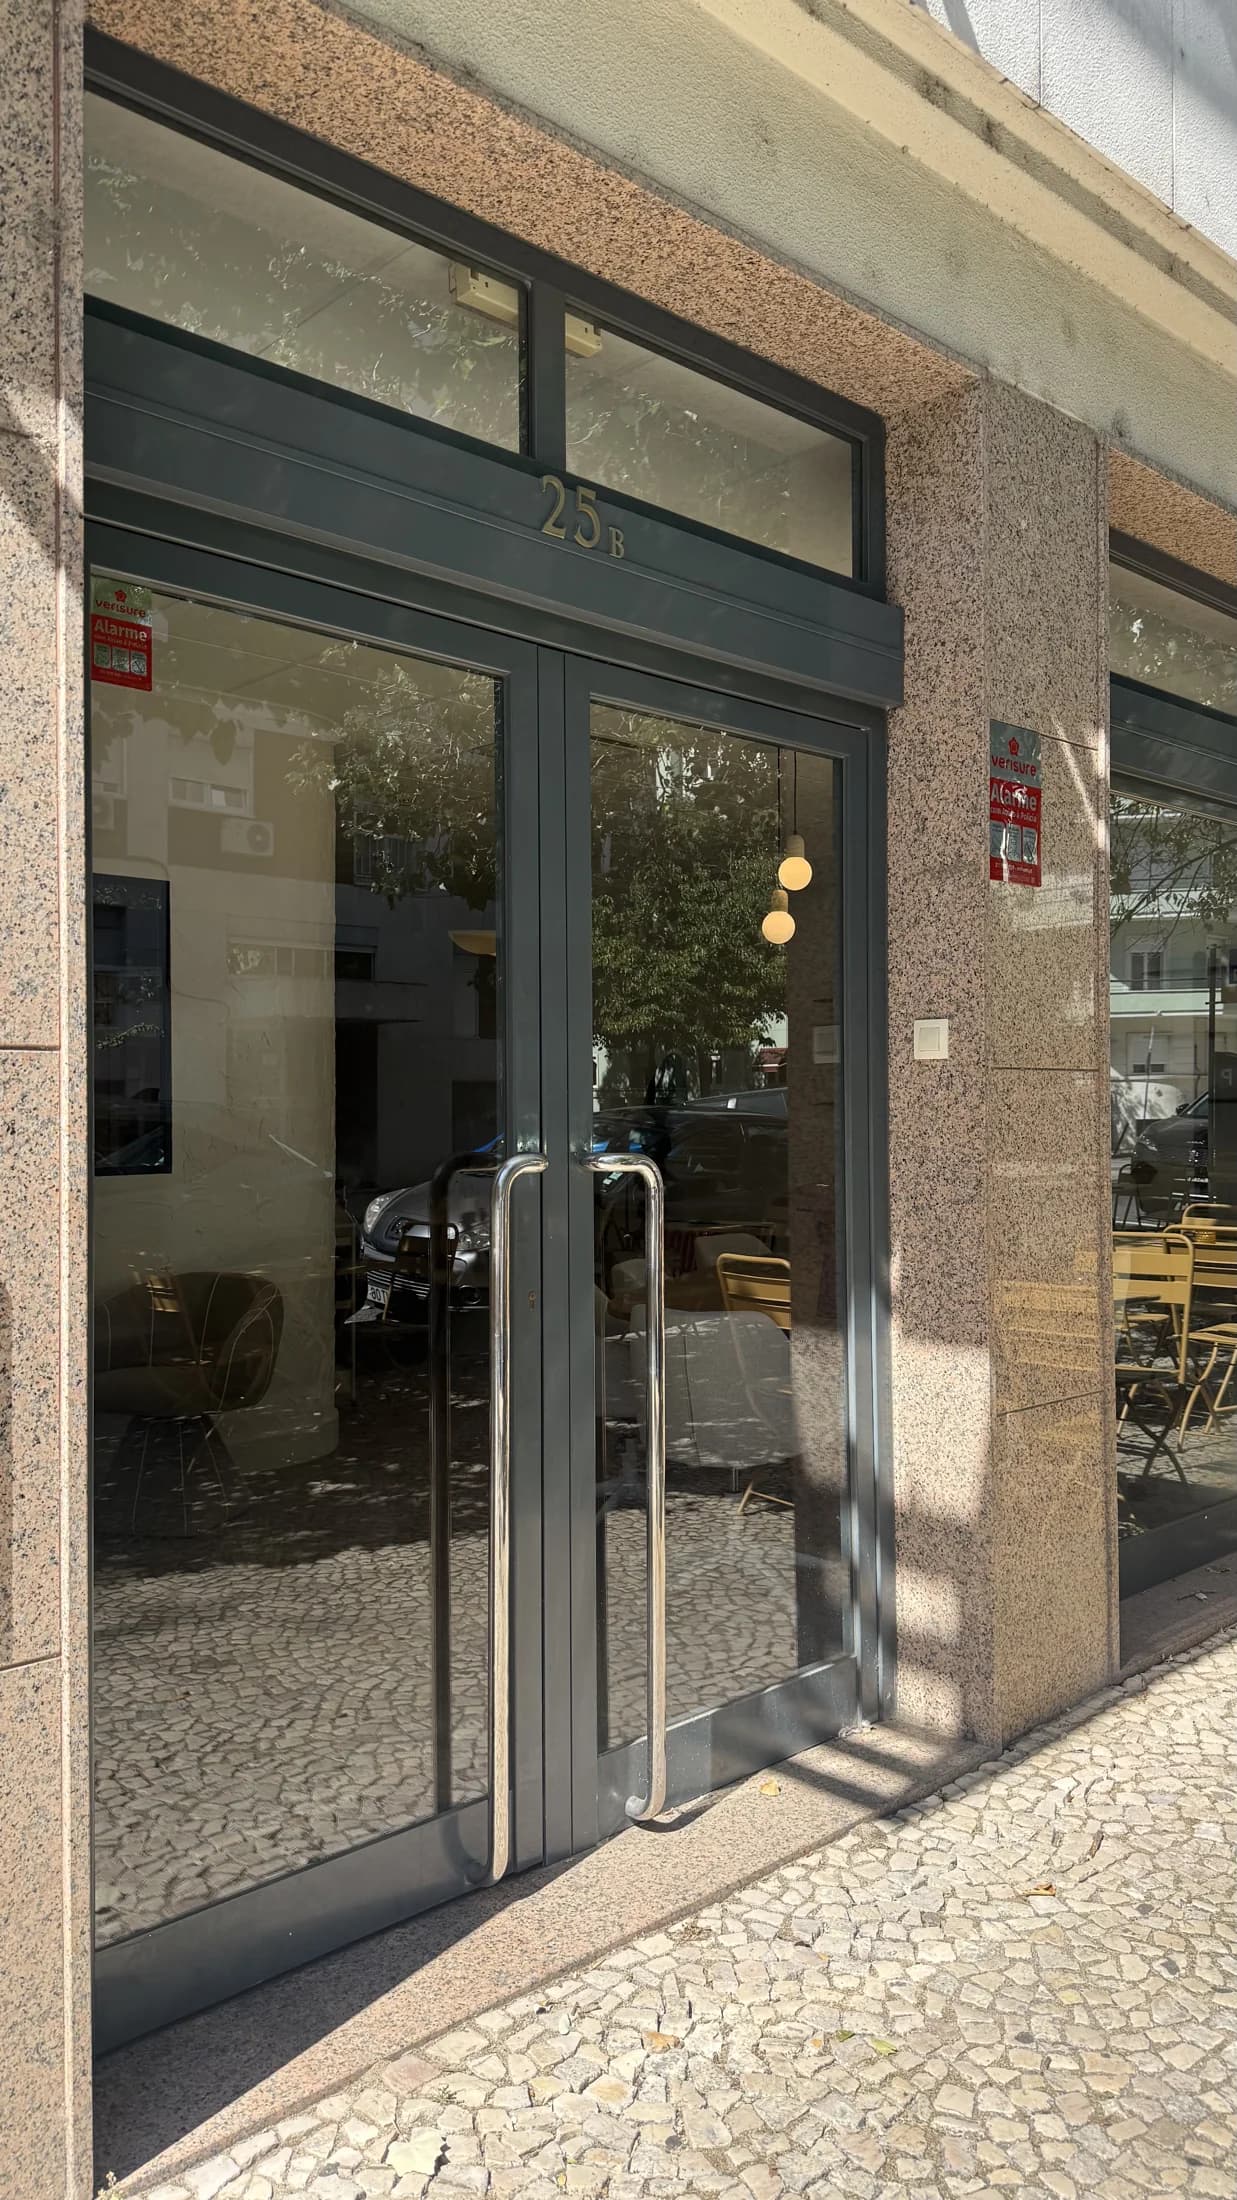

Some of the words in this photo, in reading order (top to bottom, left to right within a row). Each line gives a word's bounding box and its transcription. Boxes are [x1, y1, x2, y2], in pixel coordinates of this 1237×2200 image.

[95, 599, 147, 618] verisure
[94, 618, 148, 642] Alarme
[991, 754, 1037, 777] verisure
[990, 782, 1037, 811] Alarme
